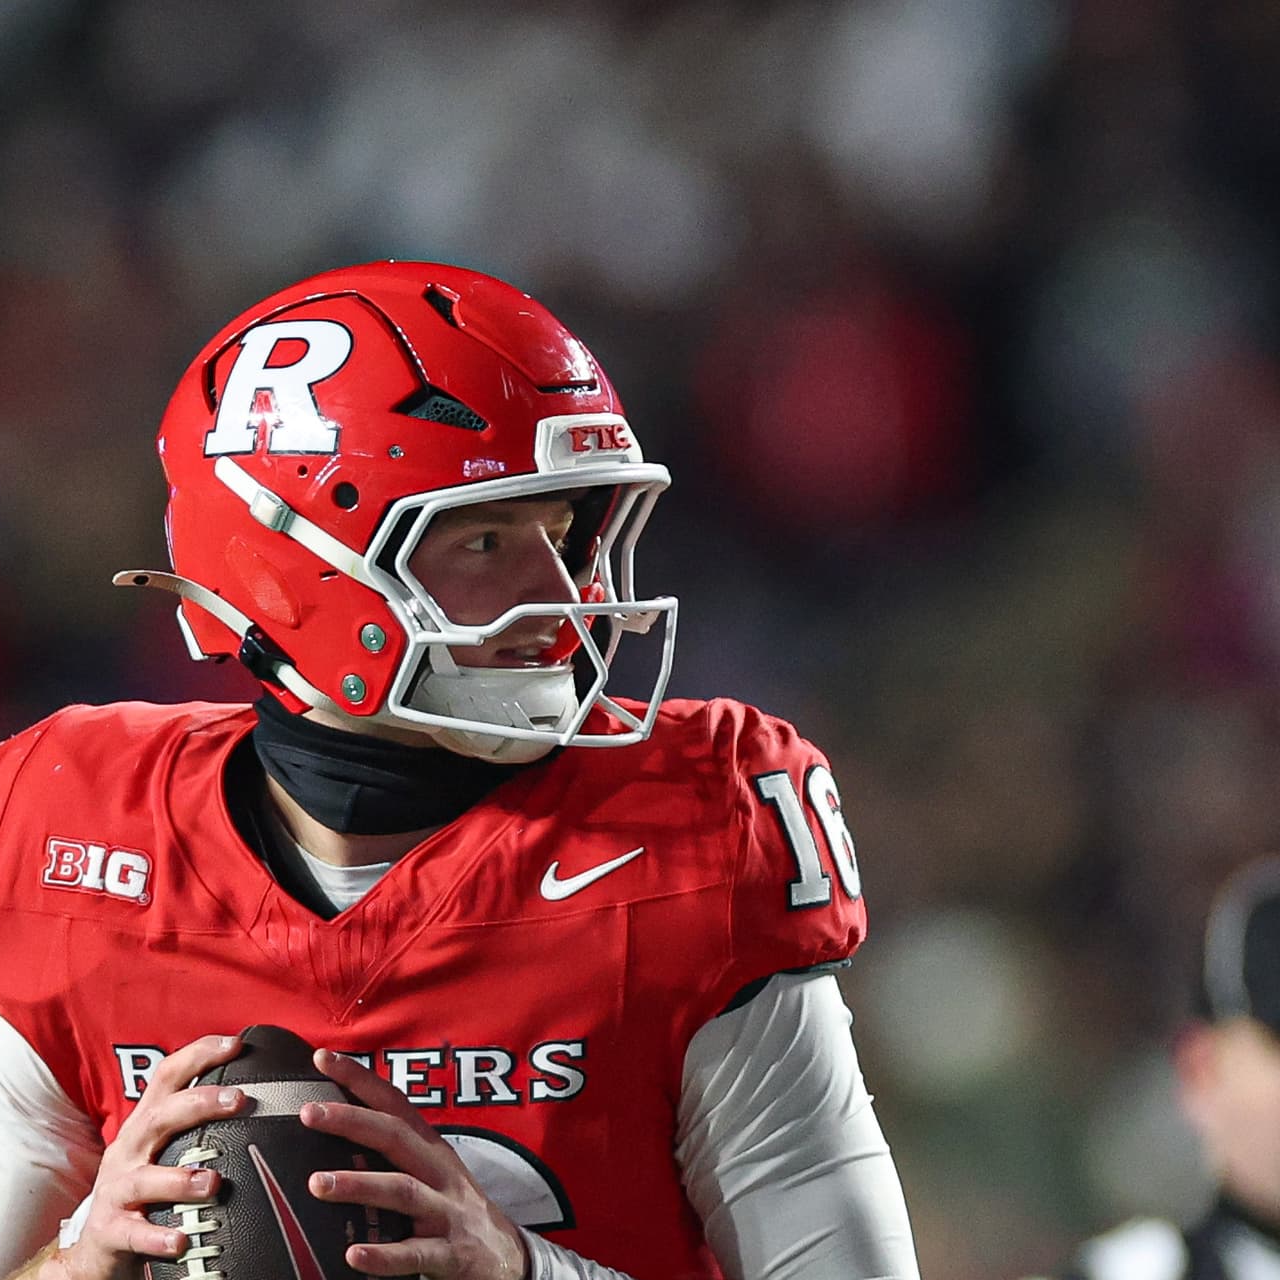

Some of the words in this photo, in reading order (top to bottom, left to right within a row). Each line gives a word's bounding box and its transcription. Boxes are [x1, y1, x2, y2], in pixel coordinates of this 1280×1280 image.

[204, 319, 353, 458] R
[42, 837, 150, 900] BIG
[754, 763, 863, 911] 16
[112, 1039, 588, 1108] RERS
